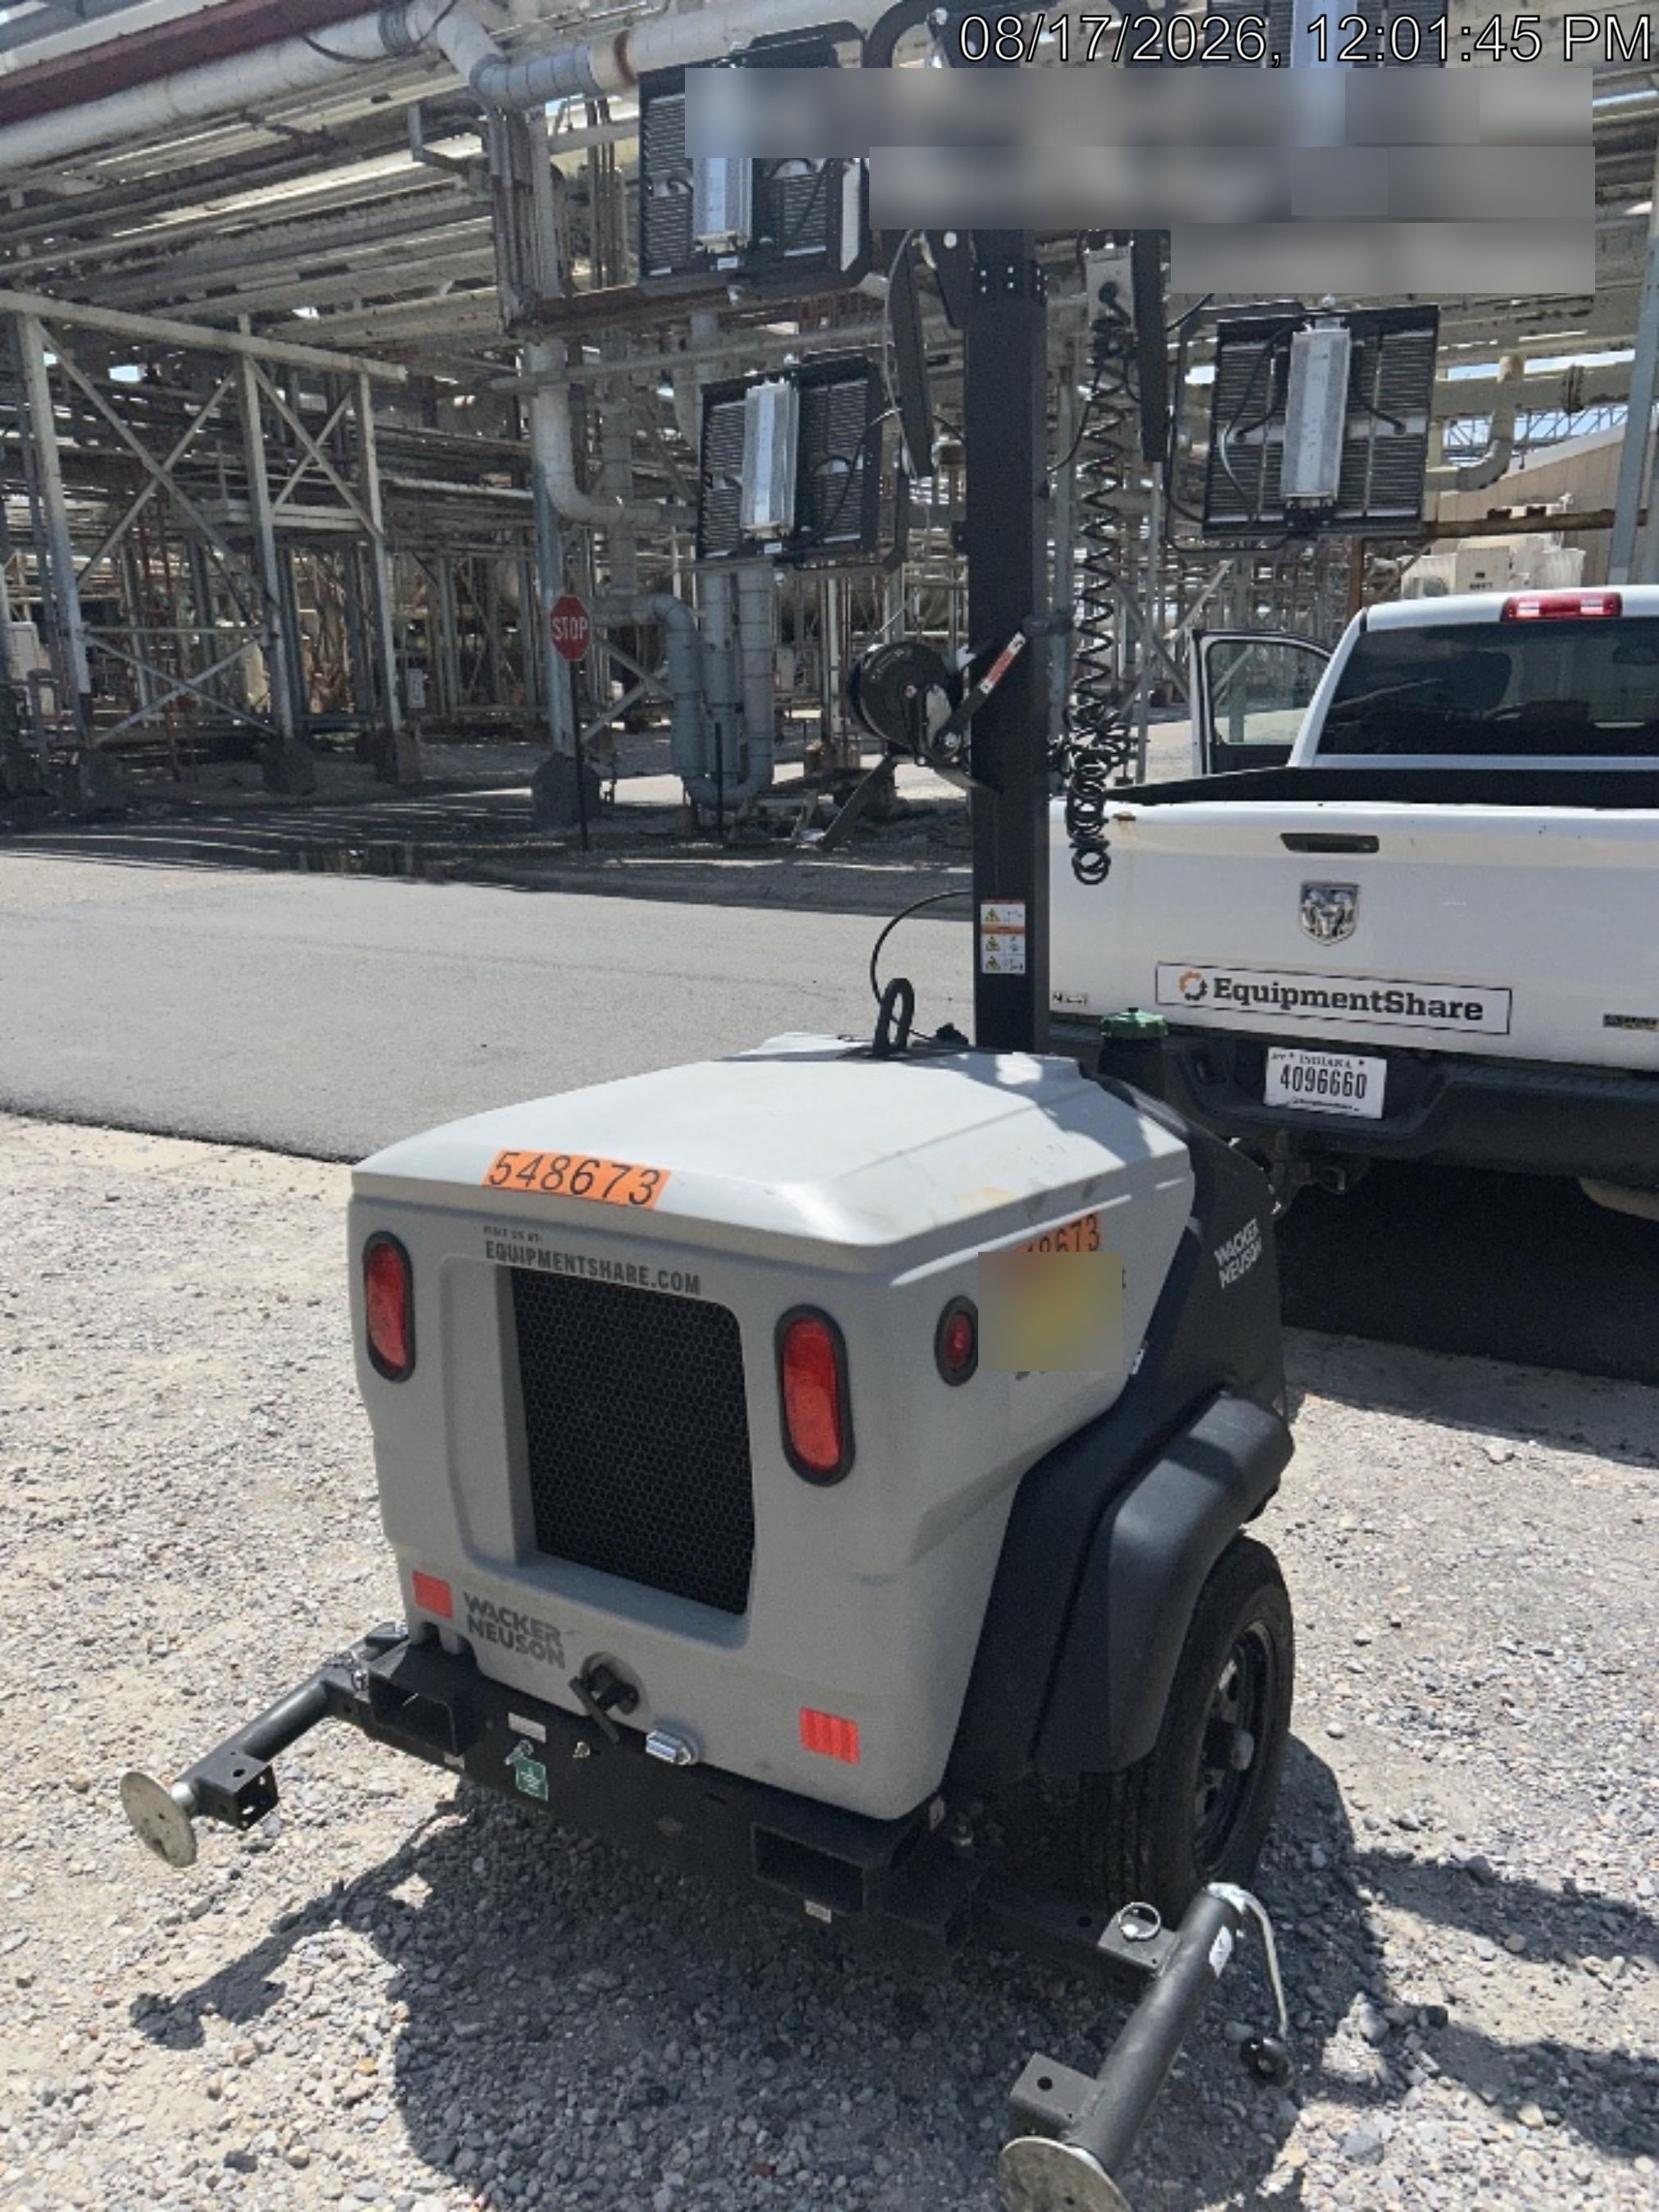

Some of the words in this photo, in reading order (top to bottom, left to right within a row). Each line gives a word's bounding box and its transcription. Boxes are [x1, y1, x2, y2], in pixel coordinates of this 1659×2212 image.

[551, 616, 588, 641] STOP
[1213, 977, 1484, 1021] EquipmentShare
[1281, 1064, 1367, 1099] 4096660
[489, 1152, 660, 1206] 548673
[486, 1240, 701, 1295] EQUIPMENTSHARE.COM
[1214, 1217, 1259, 1267] WACKER
[1218, 1235, 1262, 1289] NEUSON
[463, 1590, 563, 1648] WACKER
[466, 1614, 565, 1670] NEUSON
